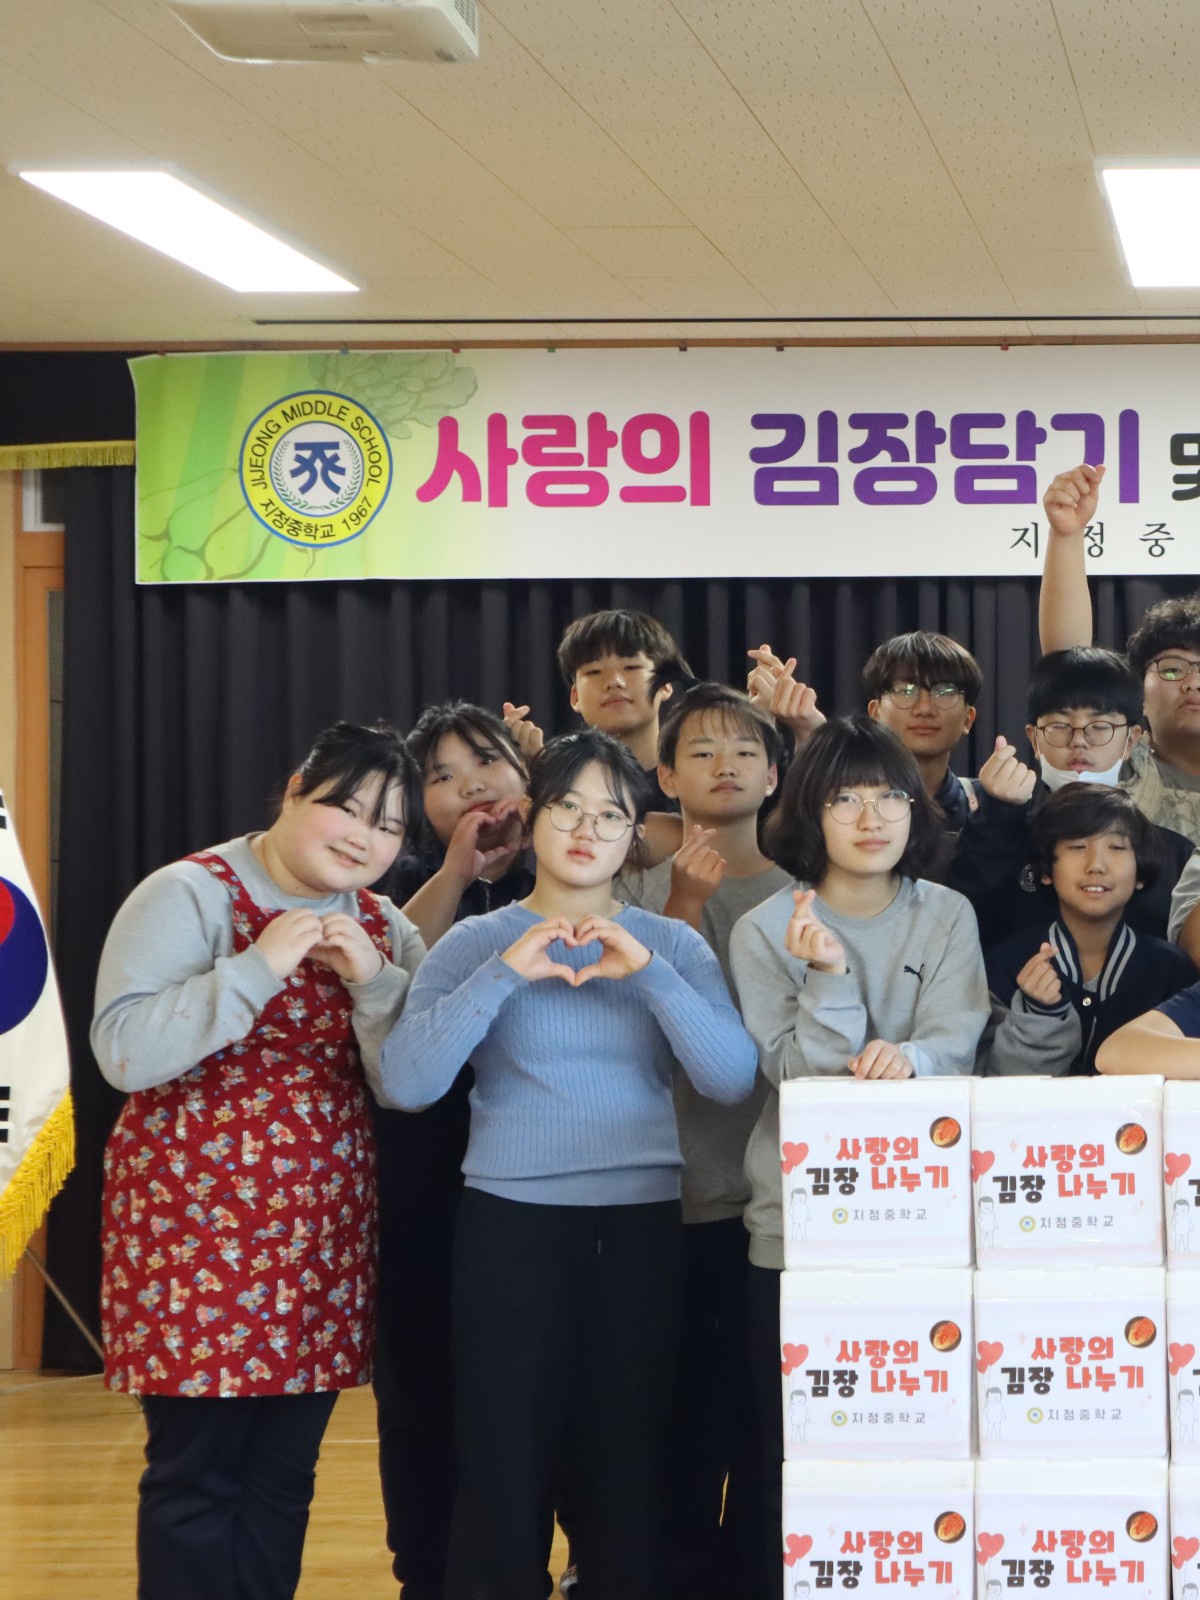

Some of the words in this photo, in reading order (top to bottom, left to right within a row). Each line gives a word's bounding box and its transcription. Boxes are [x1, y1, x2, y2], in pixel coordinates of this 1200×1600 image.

[250, 419, 282, 490] JIJEONG
[281, 400, 350, 423] MIDDLE
[351, 416, 383, 488] SCHOOL
[417, 412, 710, 506] 사랑의
[750, 410, 1139, 505] 김장담기
[260, 498, 336, 540] 지정중학교
[341, 496, 373, 531] 1967
[836, 1137, 919, 1165] 사랑의
[1023, 1143, 1106, 1171] 사랑의
[807, 1168, 858, 1194] 김장
[872, 1164, 948, 1193] 나누기
[993, 1176, 1045, 1203] 김장
[1059, 1170, 1134, 1199] 나누기
[852, 1208, 927, 1222] 지정중학교
[1040, 1215, 1114, 1229] 지정중학교
[836, 1339, 919, 1367] 사랑의
[1031, 1337, 1114, 1365] 사랑의
[807, 1370, 858, 1397] 김장
[872, 1368, 947, 1397] 나누기
[1002, 1367, 1053, 1394] 김장
[1067, 1364, 1143, 1393] 나누기
[851, 1411, 926, 1425] 지정중학교
[1047, 1408, 1122, 1421] 지정중학교
[840, 1531, 923, 1559] 사랑의
[1032, 1529, 1115, 1557] 사랑의
[811, 1561, 862, 1588] 김장
[876, 1558, 952, 1587] 나누기
[1002, 1560, 1054, 1587] 김장
[1067, 1558, 1144, 1587] 나누기
